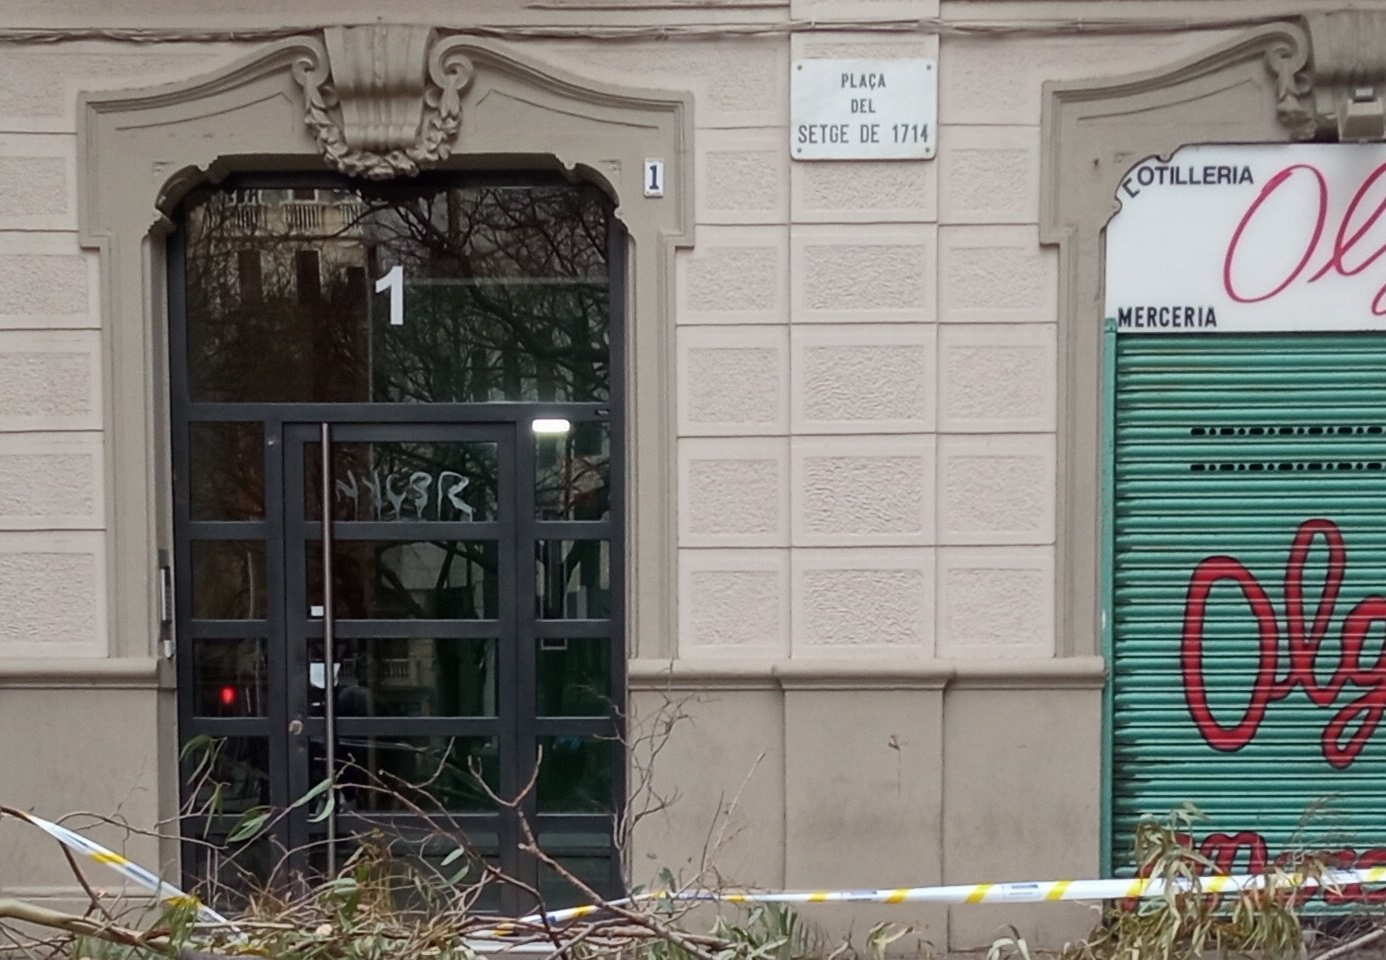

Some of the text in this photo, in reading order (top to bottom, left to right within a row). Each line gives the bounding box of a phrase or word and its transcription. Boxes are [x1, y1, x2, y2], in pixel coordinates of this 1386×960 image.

[841, 73, 887, 90] PLAÇA
[851, 98, 876, 115] DEL
[798, 123, 929, 144] SETGE DE 1714
[648, 164, 660, 190] 1
[375, 265, 405, 326] 1
[1117, 306, 1218, 328] MERCERIA
